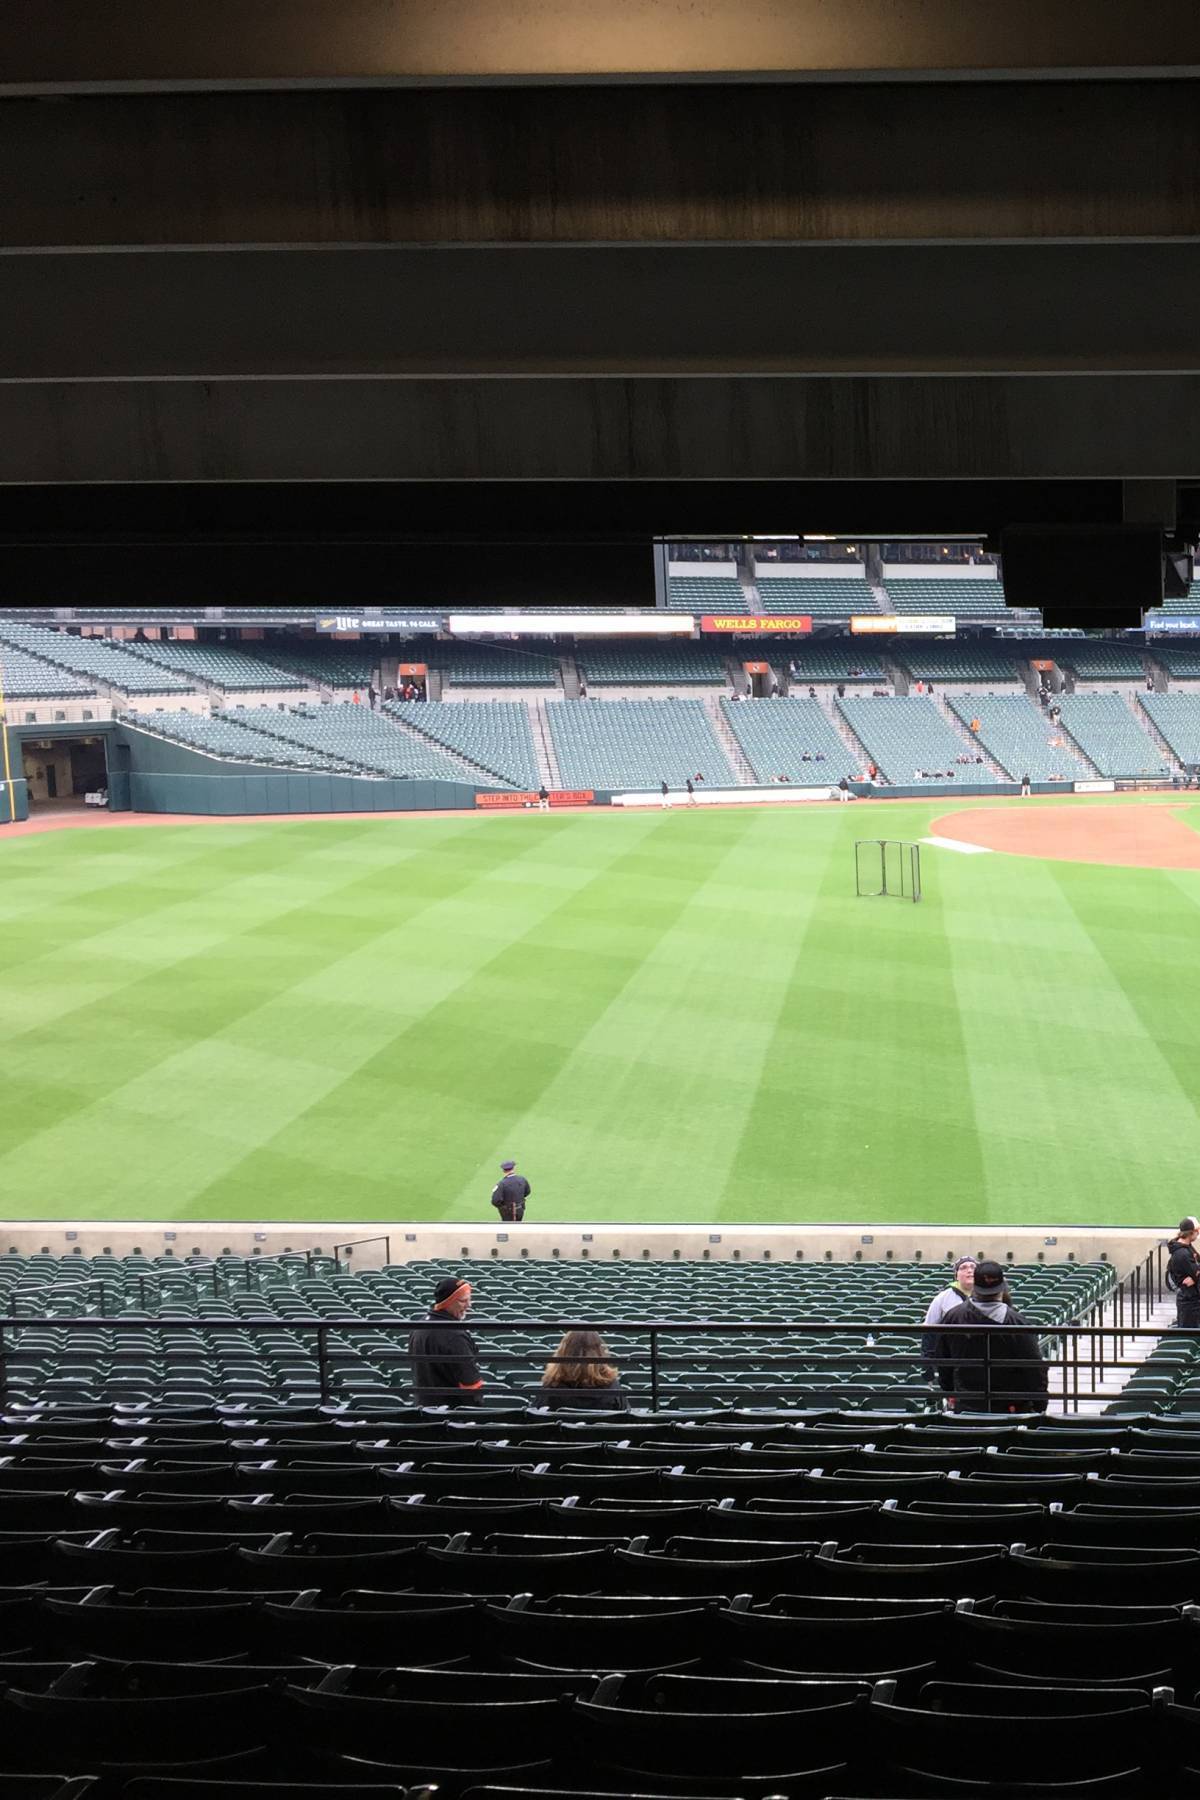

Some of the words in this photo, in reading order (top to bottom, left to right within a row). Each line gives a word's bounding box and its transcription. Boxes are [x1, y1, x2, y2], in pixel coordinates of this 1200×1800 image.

[336, 616, 359, 631] Lite
[713, 619, 757, 629] WELLS
[759, 619, 801, 629] FARGO
